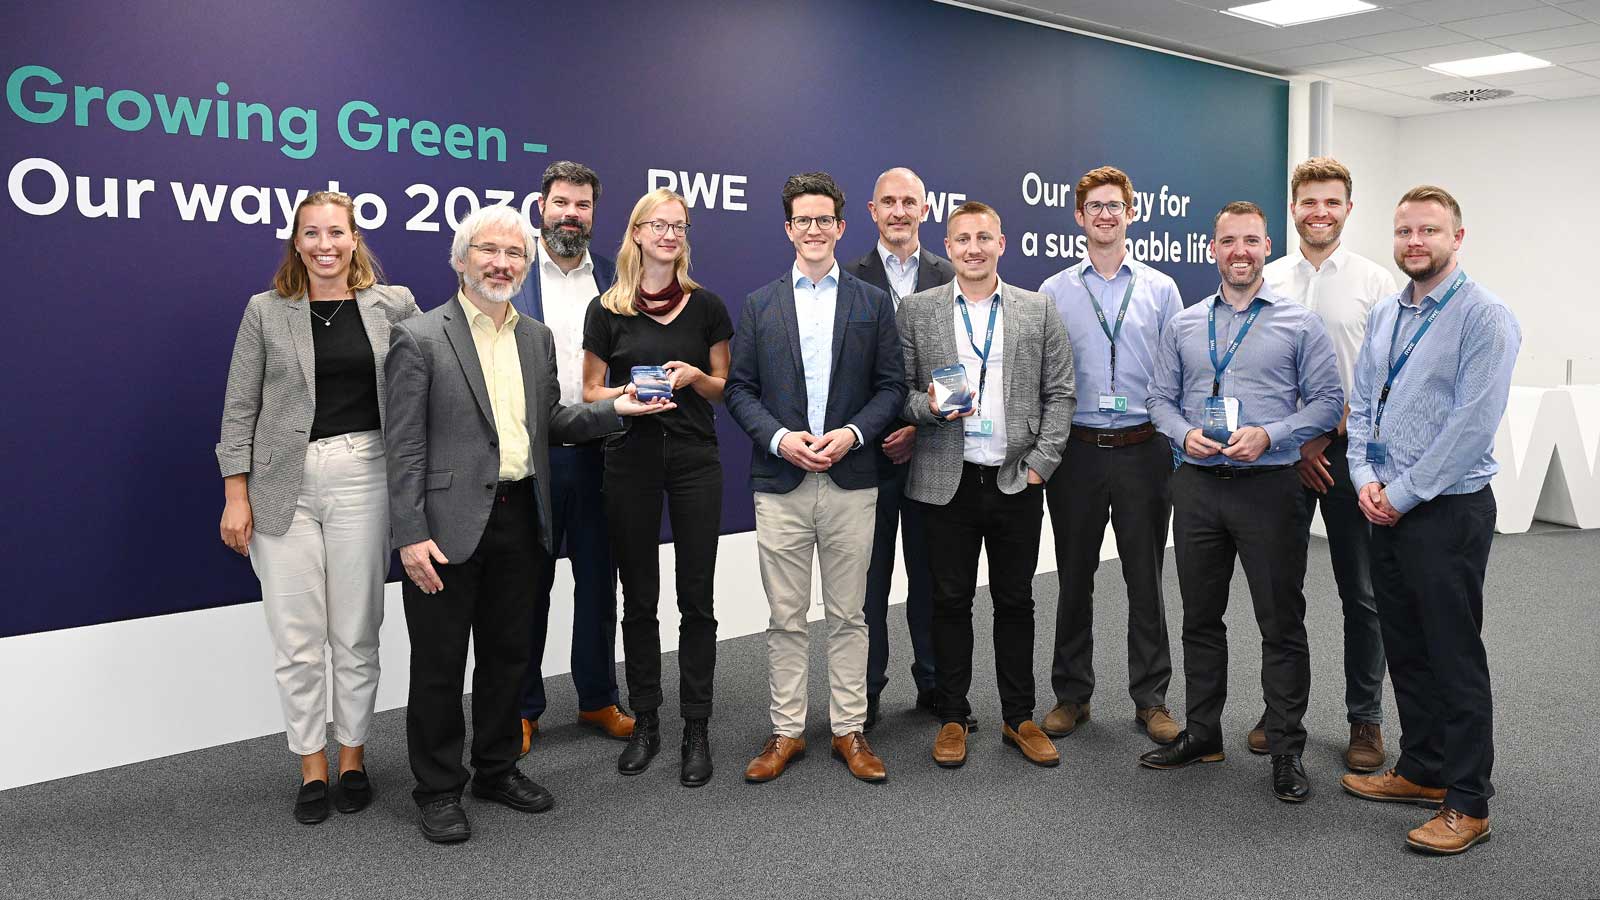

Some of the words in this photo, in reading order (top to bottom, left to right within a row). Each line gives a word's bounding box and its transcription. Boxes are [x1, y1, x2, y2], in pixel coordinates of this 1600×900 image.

[6, 65, 318, 159] Growing
[337, 100, 507, 162] Green
[7, 157, 155, 219] Our
[169, 181, 310, 240] way
[648, 168, 748, 211] RWE
[922, 191, 967, 223] WE
[1022, 172, 1071, 208] Our
[1159, 184, 1190, 217] for
[1021, 231, 1038, 257] a
[1045, 230, 1182, 263] susnable
